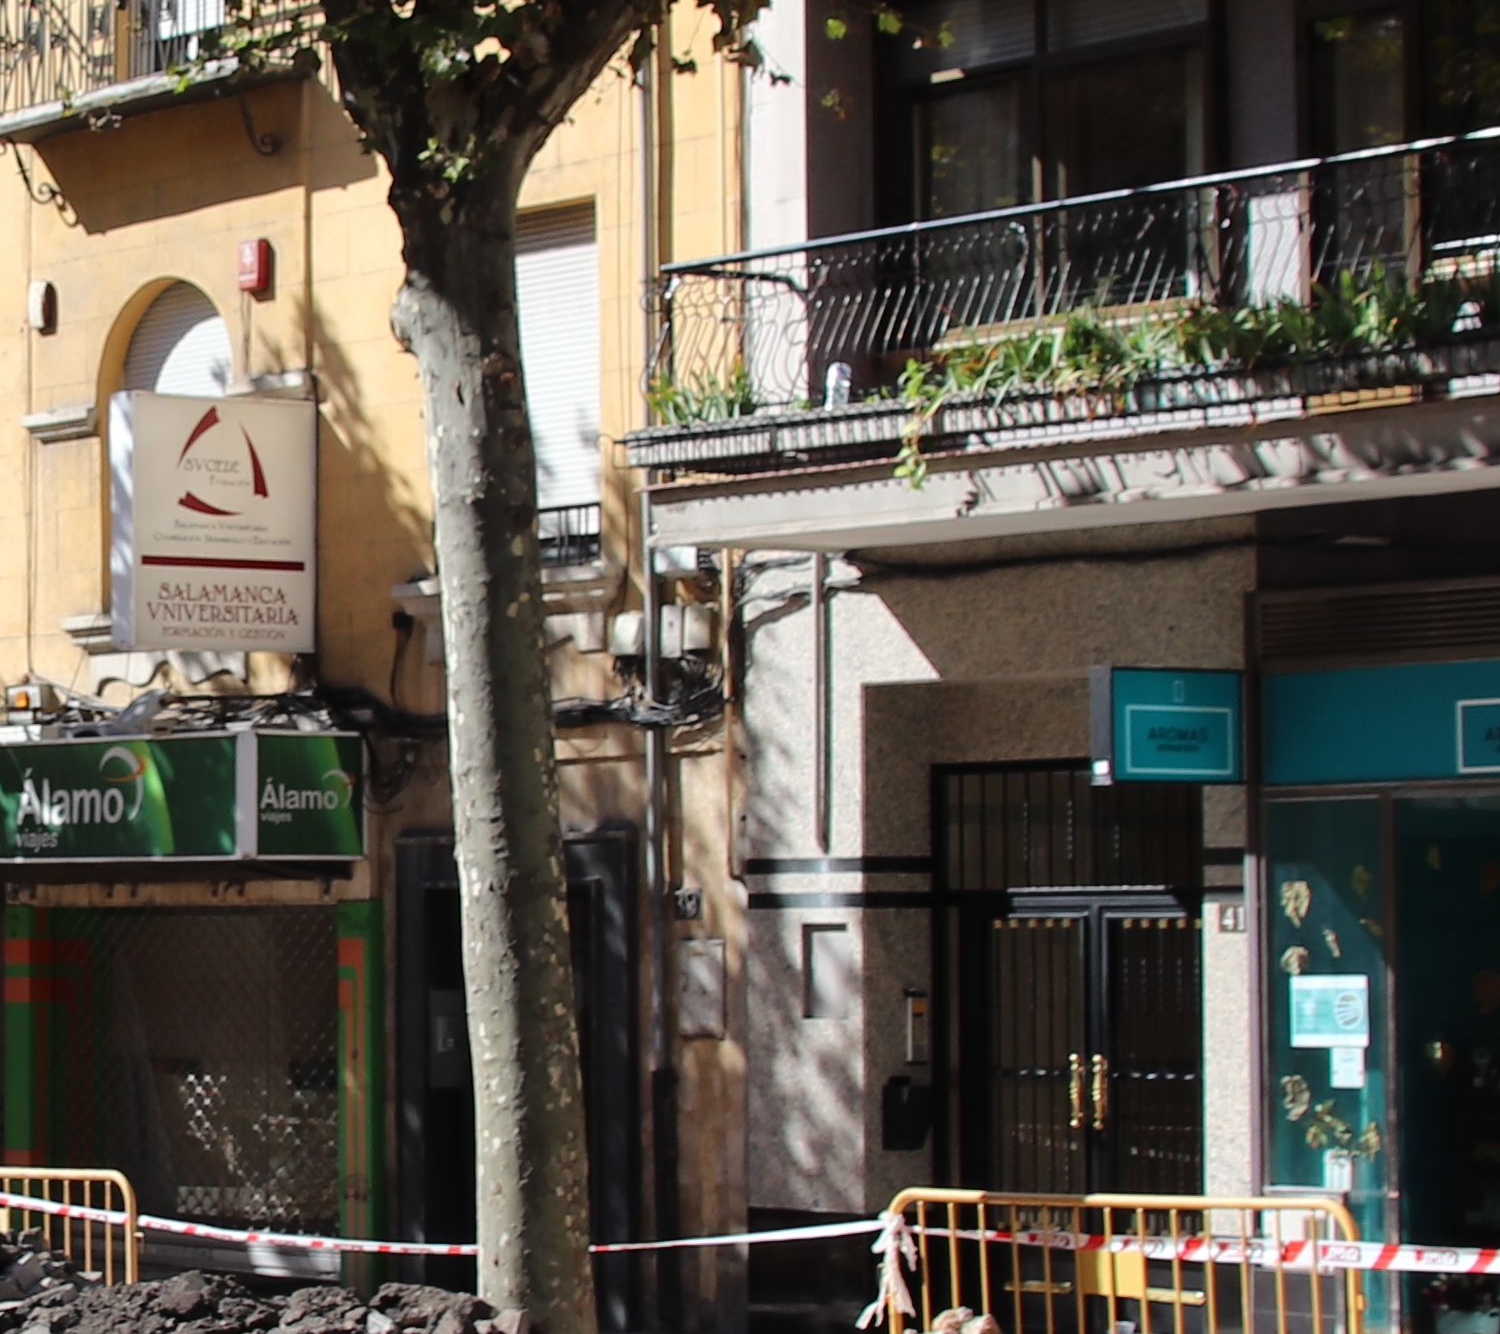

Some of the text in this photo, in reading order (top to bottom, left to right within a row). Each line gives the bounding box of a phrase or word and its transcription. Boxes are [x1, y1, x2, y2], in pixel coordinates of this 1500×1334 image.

[157, 581, 288, 605] SALAMANCA
[16, 767, 125, 826] Álamo
[261, 777, 339, 810] Álamo
[261, 810, 293, 824] viajes
[15, 828, 59, 853] viajes
[1222, 903, 1247, 932] 41
